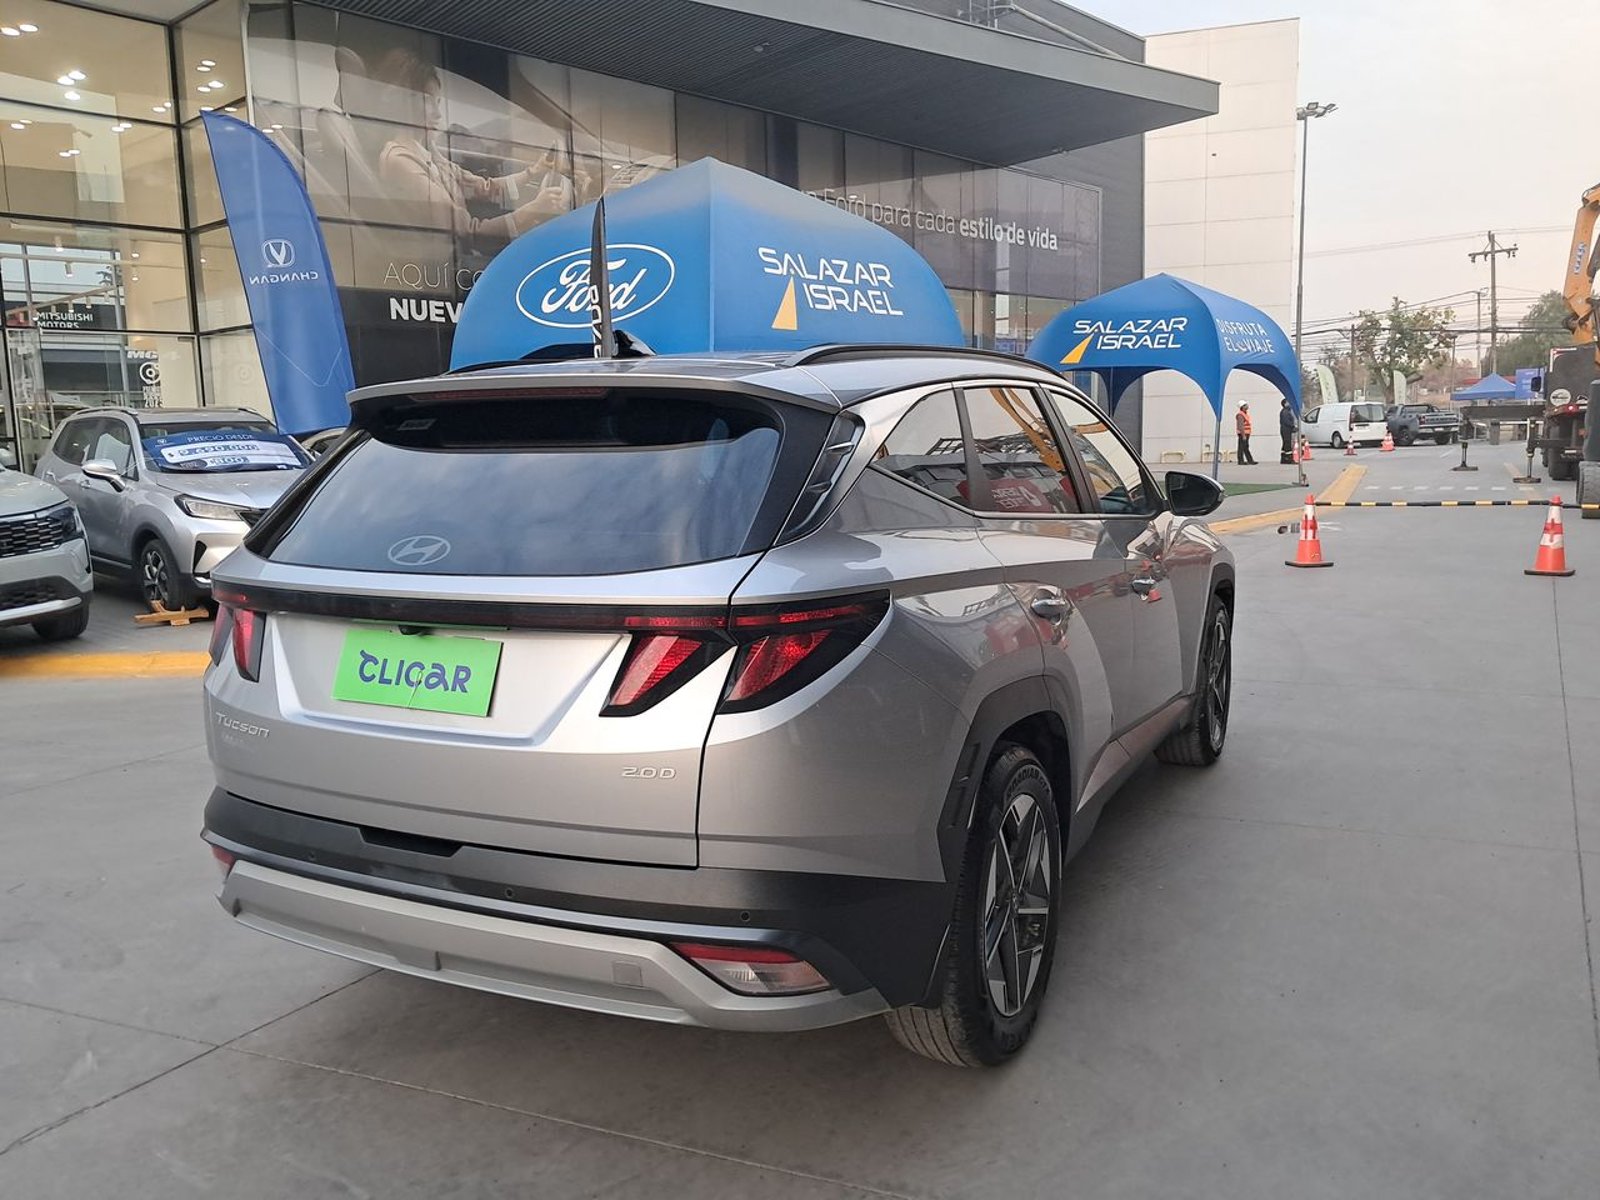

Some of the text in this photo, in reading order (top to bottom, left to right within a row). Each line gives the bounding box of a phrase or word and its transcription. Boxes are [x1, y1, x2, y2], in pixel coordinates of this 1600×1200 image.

[872, 202, 912, 228] para
[916, 212, 956, 234] cada
[959, 217, 1004, 242] estilo
[1007, 221, 1025, 246] de
[1027, 226, 1058, 250] vida
[384, 262, 450, 290] AQUÍ
[758, 247, 894, 288] SALAZAR
[389, 297, 463, 324] NUEV
[802, 282, 903, 316] ISRAEL
[36, 311, 94, 322] MITSUBISHI
[1073, 317, 1188, 334] SALAZAR
[1216, 319, 1268, 336] DISFRUTA
[1096, 333, 1182, 350] ISRAEL
[215, 711, 270, 738] Tucson
